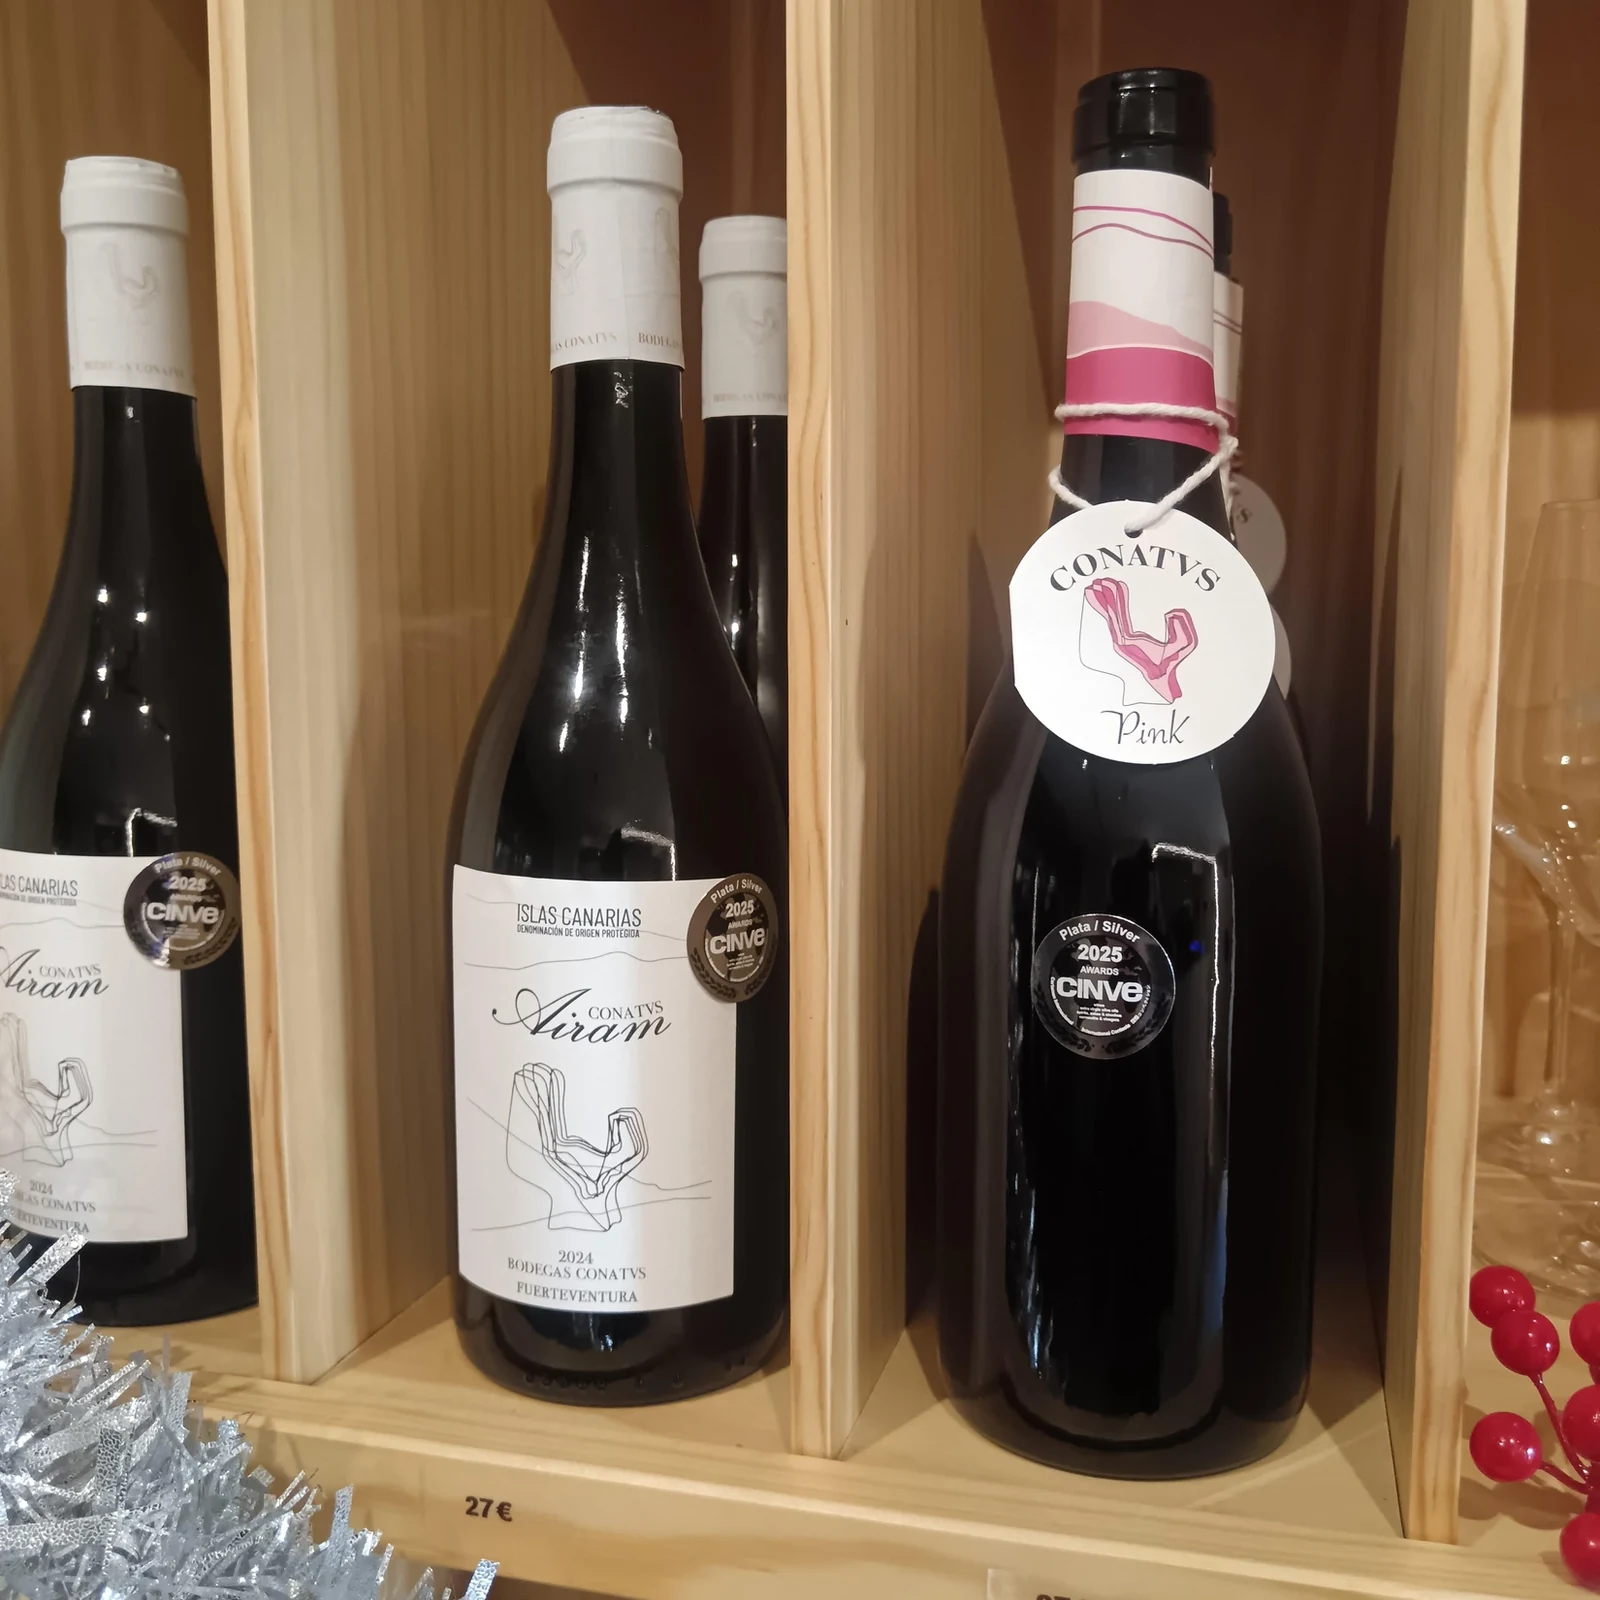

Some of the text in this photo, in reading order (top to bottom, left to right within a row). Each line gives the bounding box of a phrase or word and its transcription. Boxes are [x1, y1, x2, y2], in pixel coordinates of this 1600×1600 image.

[1050, 544, 1221, 592] CONATVS
[1100, 709, 1190, 745] Pink
[154, 858, 183, 874] Plata
[192, 856, 222, 876] Silver
[18, 875, 78, 897] CANARIAS
[168, 876, 207, 892] 2025
[710, 883, 734, 903] Plata
[741, 879, 763, 894] Silver
[516, 903, 642, 928] ISLAS CANARIAS
[725, 899, 755, 918] 2025
[516, 924, 641, 938] DENOMINACIÓN DE ORIGEN PROTEGIDA
[728, 919, 753, 930] AWARDS
[1059, 922, 1091, 941] Plata
[1102, 920, 1141, 943] Silver
[1077, 944, 1123, 963] 2025
[0, 946, 110, 999] Airam
[39, 964, 102, 979] CONATVS
[1080, 966, 1120, 976] AWARDS
[492, 987, 672, 1044] Airam
[588, 1000, 664, 1020] CONATVS
[29, 1179, 53, 1195] 2024
[41, 1197, 96, 1213] CONATVS
[558, 1250, 593, 1265] 2024
[508, 1257, 647, 1280] BODEGAS CONATVS
[516, 1281, 638, 1303] FUERTEVENTURA
[465, 1495, 513, 1522] 27€
